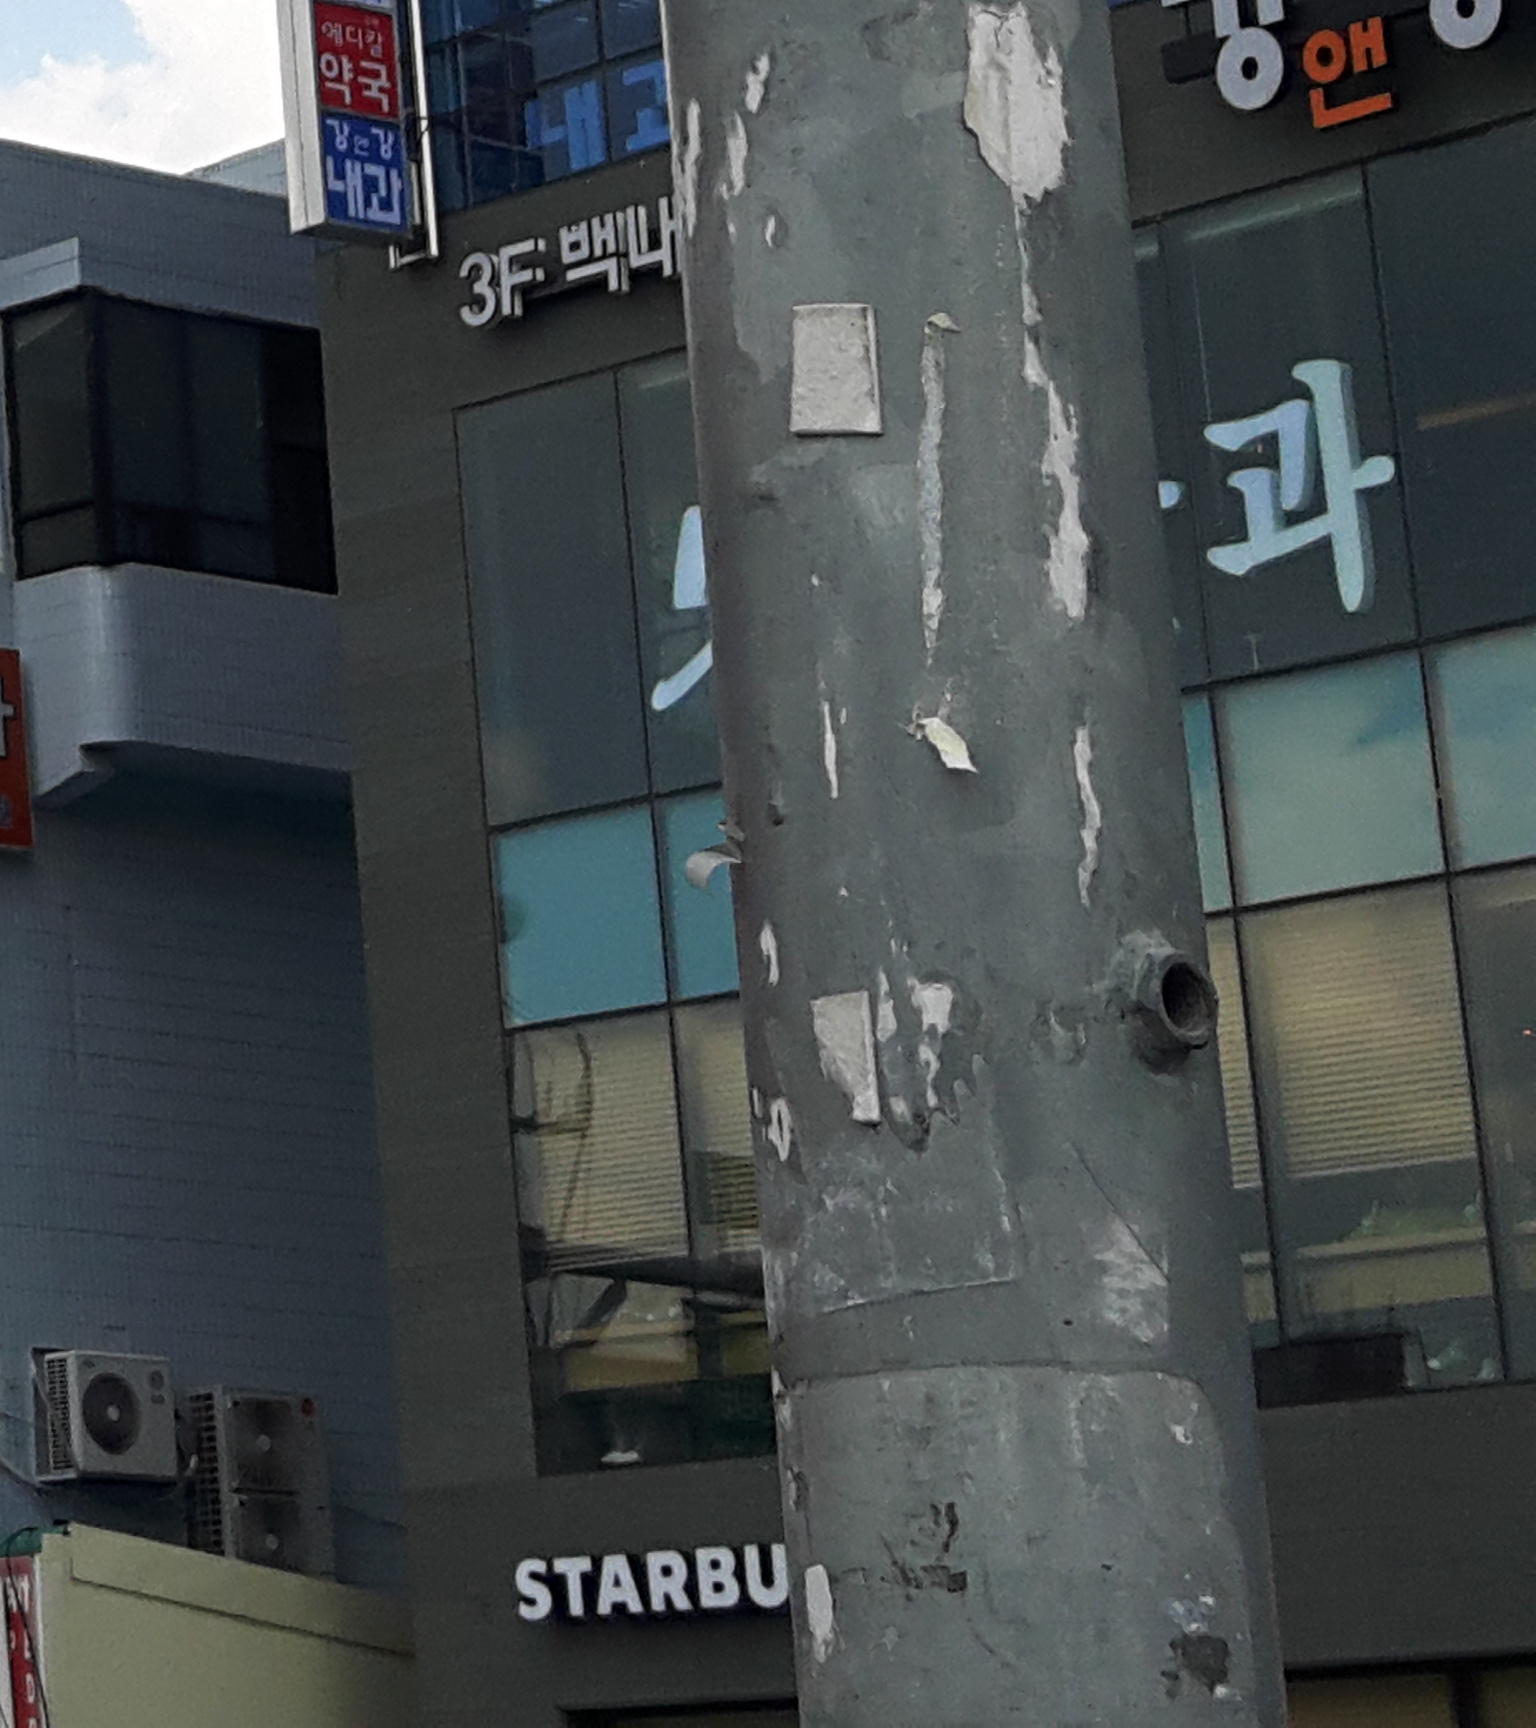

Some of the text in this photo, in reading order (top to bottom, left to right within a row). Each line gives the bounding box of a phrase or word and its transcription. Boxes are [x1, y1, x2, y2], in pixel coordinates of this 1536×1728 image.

[319, 51, 391, 115] 약국
[327, 161, 402, 227] 내과
[459, 237, 547, 328] 3F
